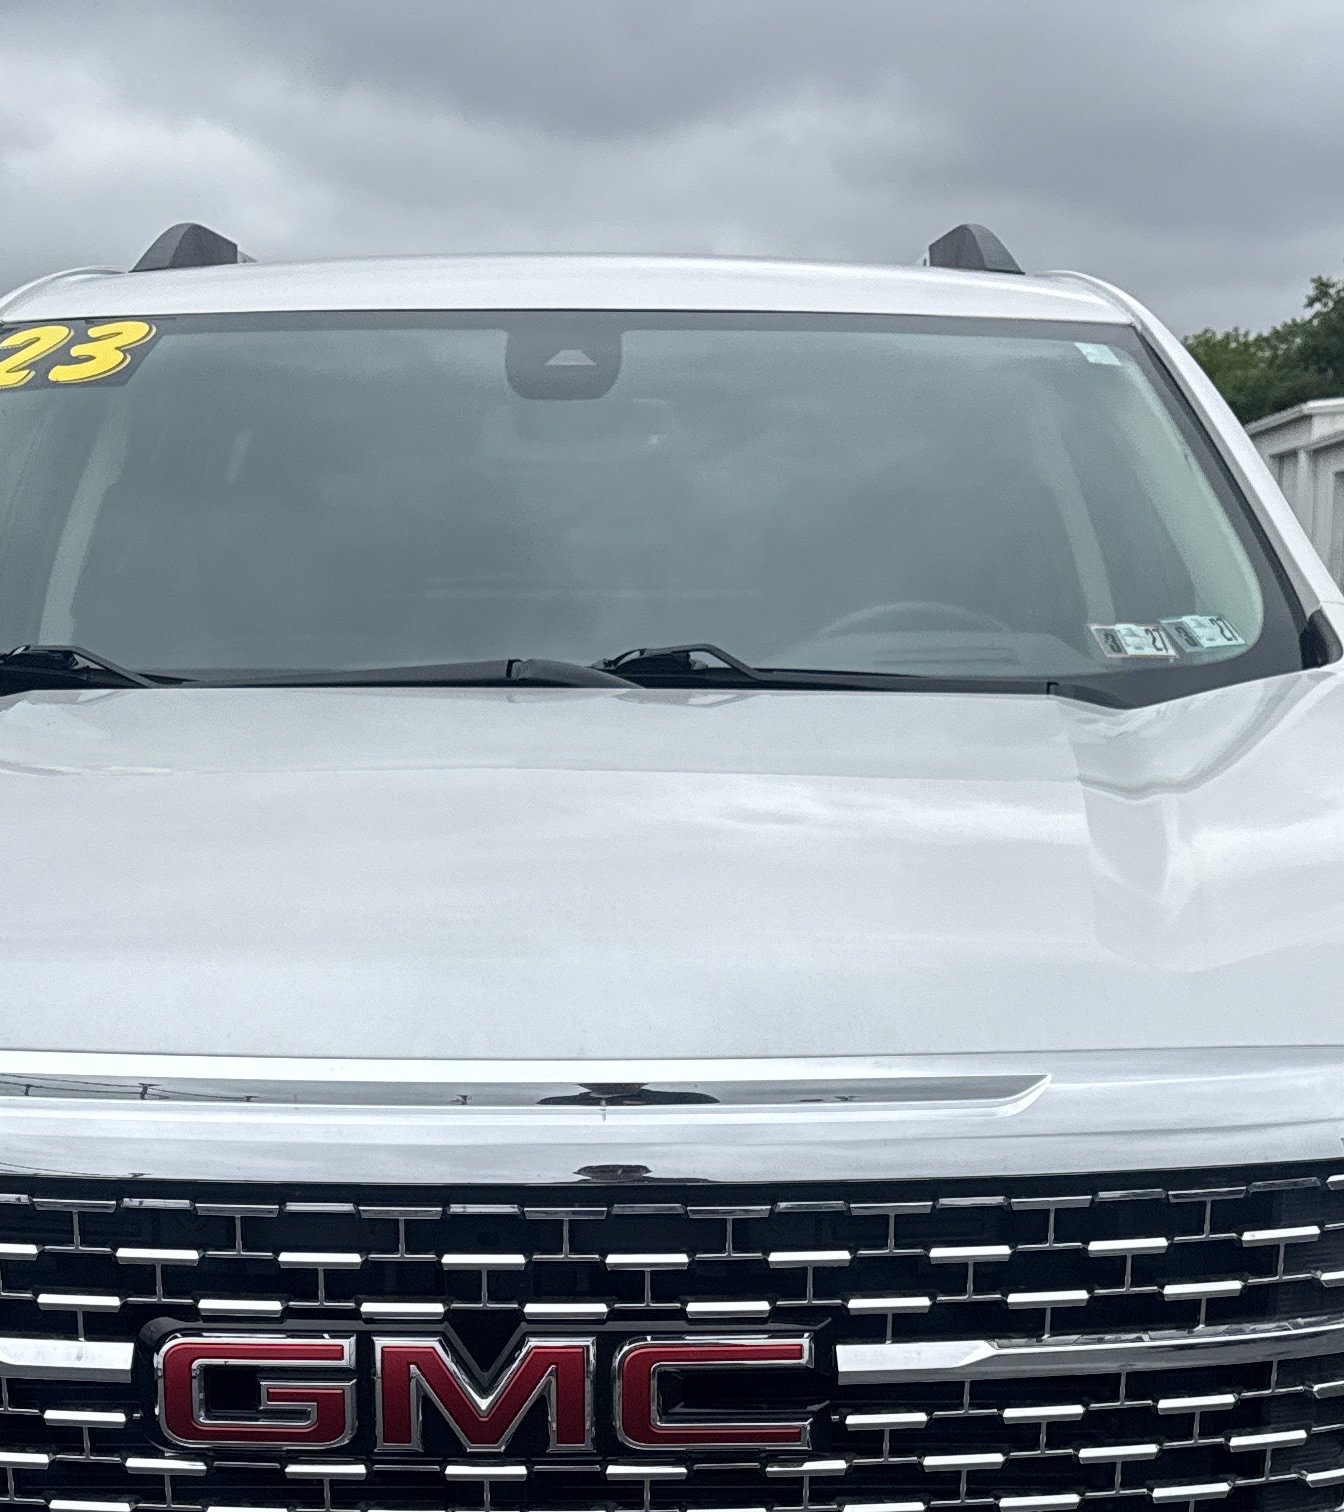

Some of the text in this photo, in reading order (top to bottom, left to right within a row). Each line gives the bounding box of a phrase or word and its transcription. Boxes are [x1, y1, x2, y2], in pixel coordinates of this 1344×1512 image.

[1103, 627, 1169, 654] 3 27
[1174, 616, 1239, 647] 3 27
[155, 1333, 815, 1453] GMC
